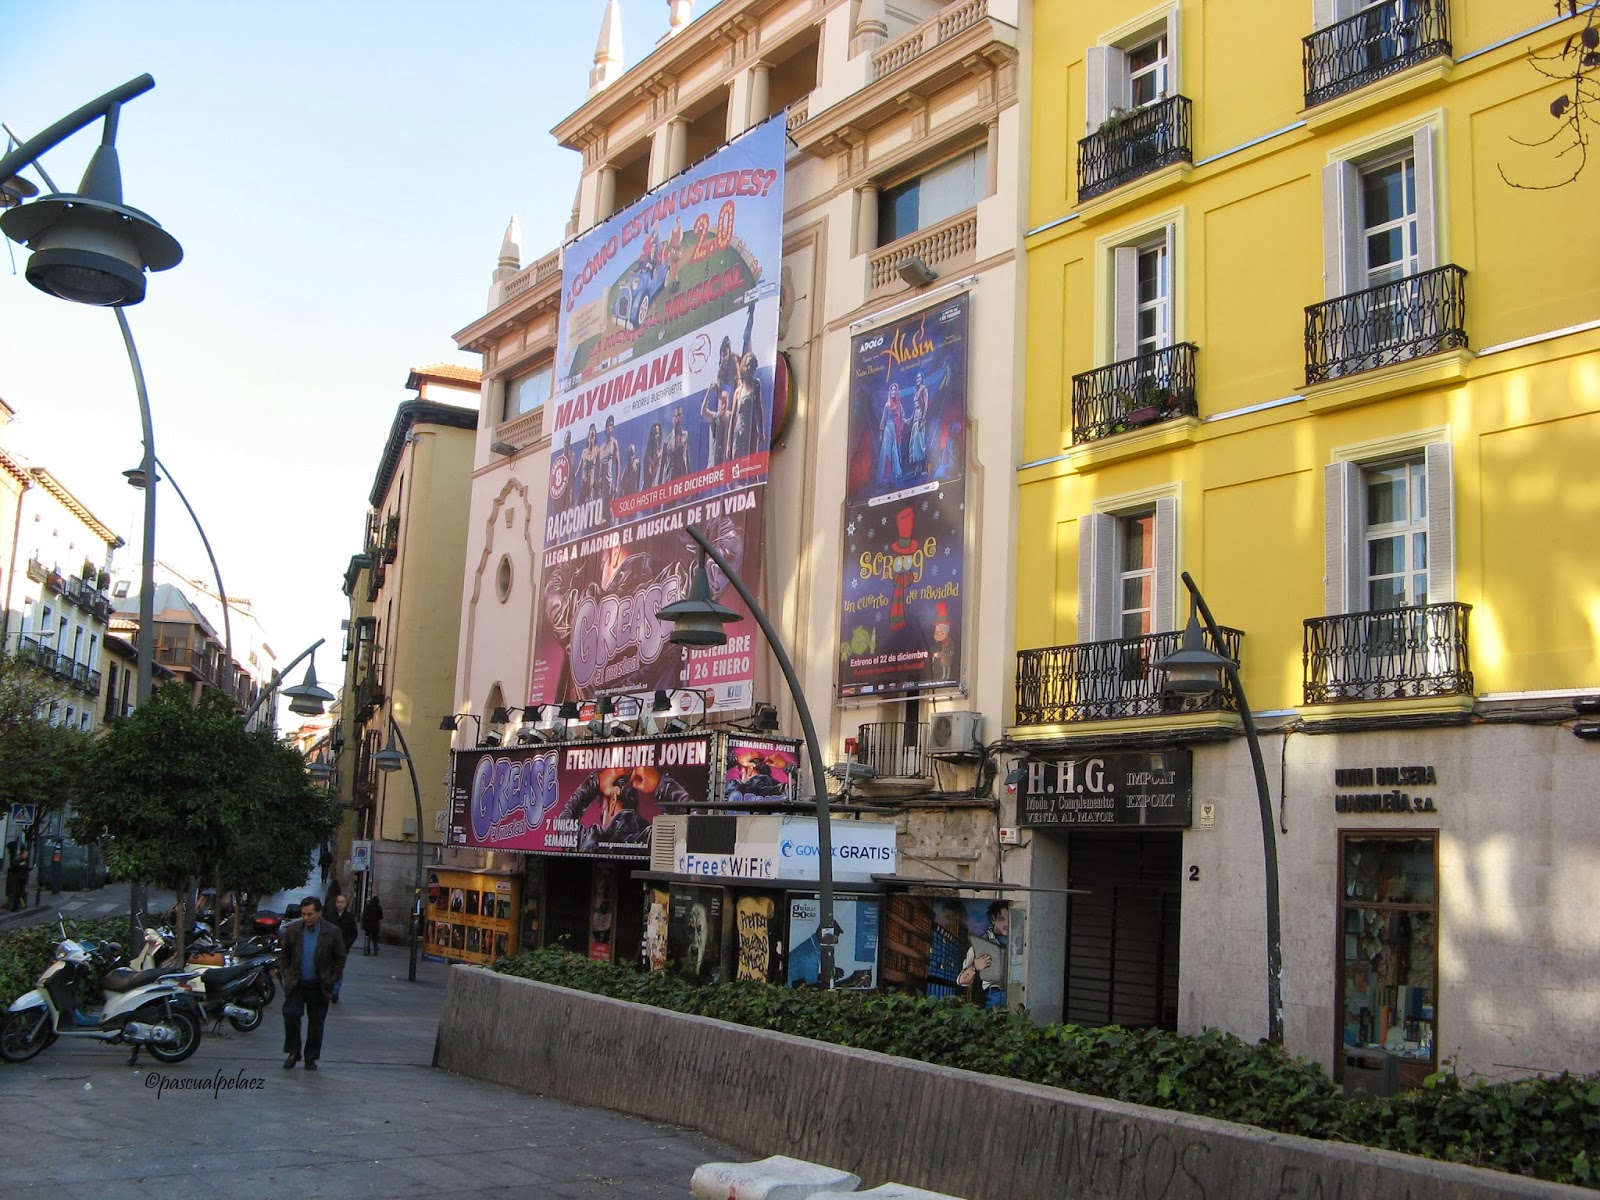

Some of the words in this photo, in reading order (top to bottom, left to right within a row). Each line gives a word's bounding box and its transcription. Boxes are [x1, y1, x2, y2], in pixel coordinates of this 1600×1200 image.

[566, 235, 619, 312] ¿CÓMO
[622, 191, 677, 248] ESTÁN
[679, 169, 777, 210] USTEDES?
[689, 200, 735, 264] 2.0
[663, 265, 746, 324] MUSICAL
[860, 337, 884, 354] APOLO
[554, 347, 684, 432] MAYUMANA
[556, 468, 563, 487] 8
[619, 499, 635, 513] SOLO
[636, 491, 658, 508] HASTA
[659, 489, 667, 500] EL
[668, 487, 672, 497] 1
[673, 484, 683, 496] DE
[684, 469, 725, 492] DICIEMBRE
[545, 547, 568, 568] LLEGA
[571, 544, 578, 560] A
[581, 532, 620, 557] MADRID
[622, 527, 633, 544] EL
[636, 514, 684, 540] MUSICAL
[687, 506, 702, 526] DE
[705, 500, 721, 521] TU
[724, 491, 756, 515] VIDA
[546, 498, 603, 542] RACCONTO
[570, 575, 680, 688] GREASE
[681, 645, 688, 660] 5
[850, 658, 872, 667] Estreno
[873, 656, 879, 664] el
[880, 655, 887, 663] 22
[888, 654, 896, 662] de
[897, 650, 928, 661] diciembre
[680, 663, 690, 681] al
[694, 662, 708, 679] 26
[712, 656, 750, 677] ENERO
[566, 744, 656, 770] ETERNAMENTE
[658, 741, 706, 766] JOVEN
[729, 739, 774, 750] ETERNAMENTE
[775, 744, 795, 753] JOVEN
[1027, 758, 1115, 794] H.H.G.
[471, 749, 559, 842] GREASE
[1026, 797, 1048, 810] Moda
[1050, 800, 1055, 812] y
[1058, 796, 1115, 812] Complementos
[1126, 794, 1175, 808] EXPORT
[546, 819, 551, 830] 7
[553, 815, 579, 831] ÚNICAS
[1026, 812, 1059, 823] VENTA
[1061, 812, 1075, 823] AL
[1078, 812, 1114, 822] MAYOR
[544, 834, 578, 847] SEMANAS
[840, 845, 890, 860] GRATIS
[687, 855, 718, 875] Free
[729, 857, 763, 877] WiFi
[1189, 866, 1199, 881] 2
